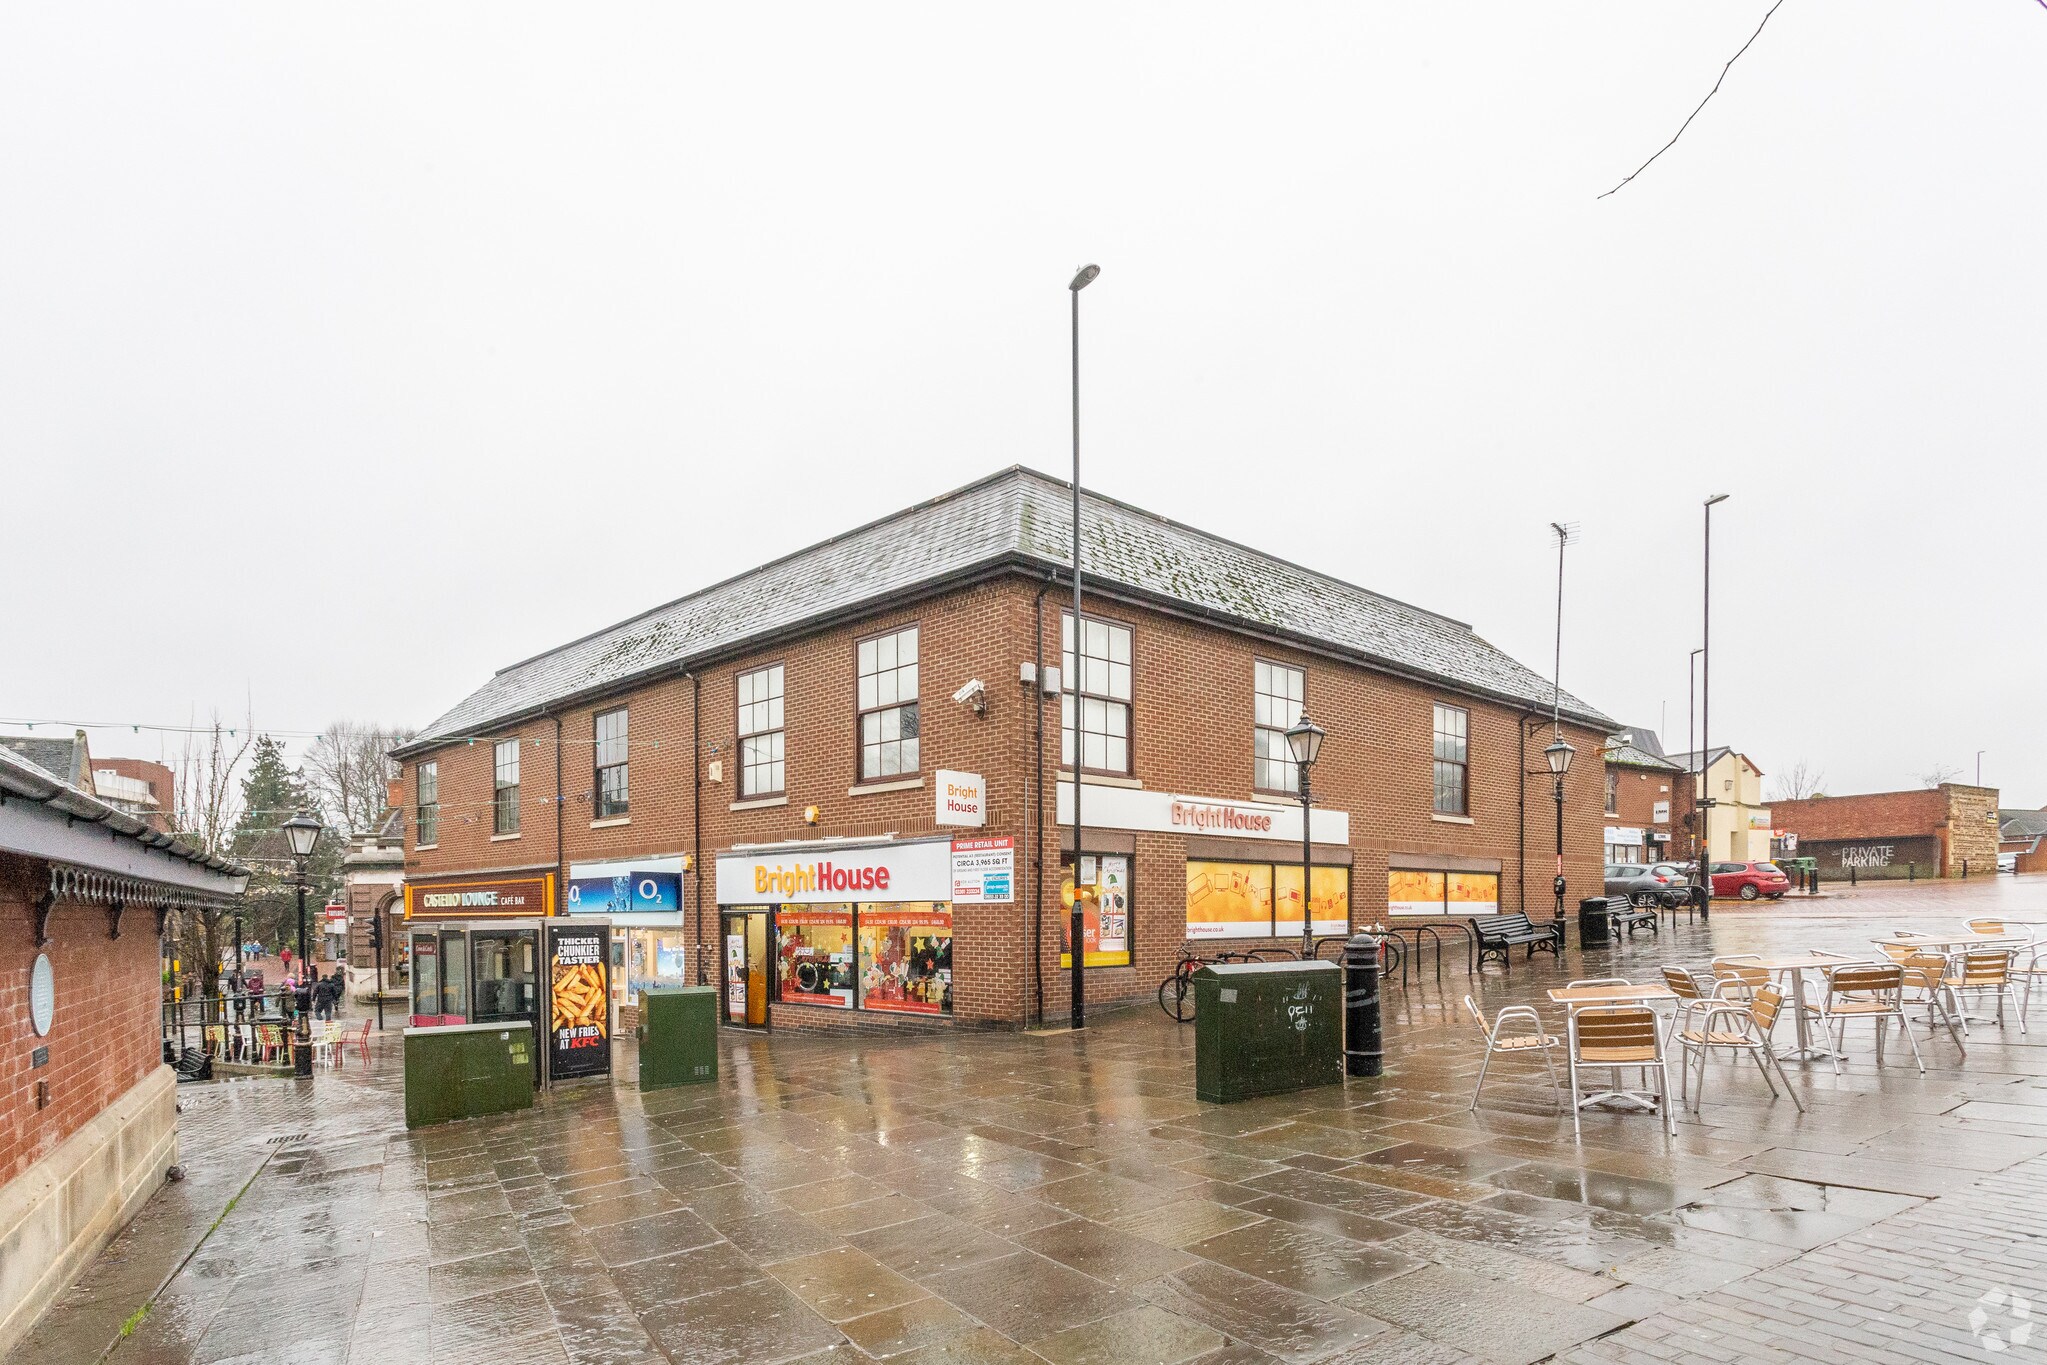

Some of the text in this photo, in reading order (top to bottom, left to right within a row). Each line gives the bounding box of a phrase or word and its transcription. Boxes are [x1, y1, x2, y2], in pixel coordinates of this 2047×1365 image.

[947, 784, 977, 799] Bright
[947, 799, 978, 813] House
[994, 839, 1008, 847] UNIT
[1842, 845, 1894, 859] PRIVATE
[975, 859, 991, 867] 3,965
[1001, 857, 1008, 865] FT
[1842, 856, 1890, 867] PARKING
[569, 885, 581, 905] O2
[639, 879, 662, 904] O2
[424, 891, 525, 907] CASTELLO LOUNGE CAFÉ BAR
[557, 937, 600, 945] THICKER
[557, 945, 600, 957] CHUNKIER
[558, 956, 600, 965] TASTIER
[559, 1025, 600, 1039] NEW FRIES
[560, 1036, 599, 1050] AT KFC
